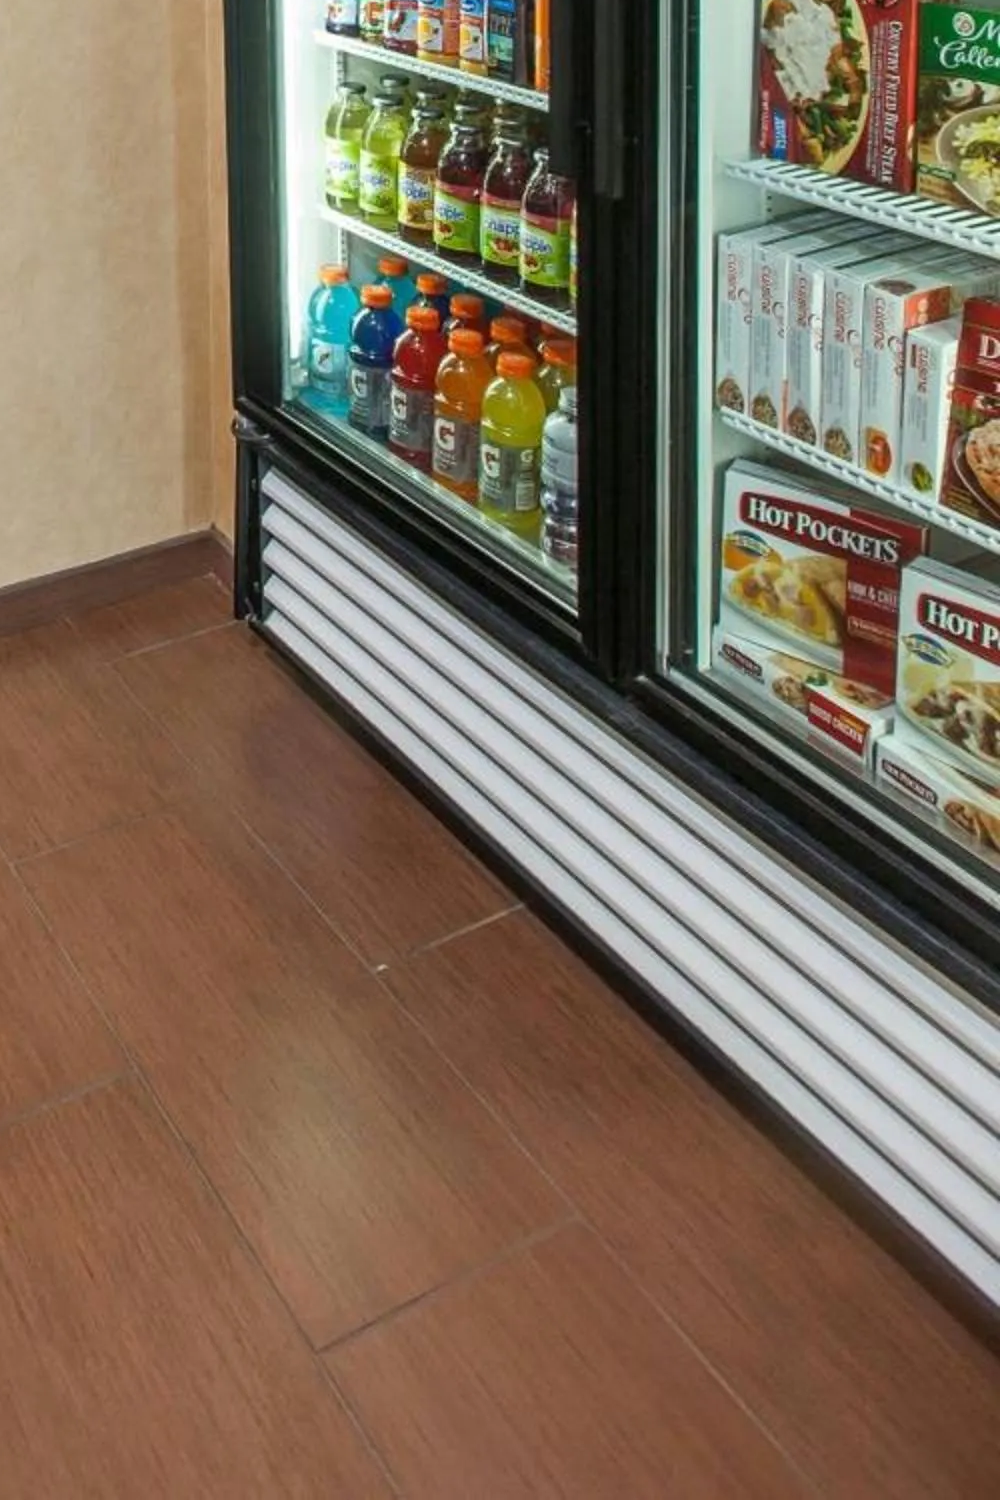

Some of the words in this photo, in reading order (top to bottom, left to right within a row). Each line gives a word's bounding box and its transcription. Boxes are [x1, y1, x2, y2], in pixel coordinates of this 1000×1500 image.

[886, 19, 904, 73] COUNTRY
[884, 73, 900, 112] FRIED
[880, 145, 897, 184] STEAK
[747, 497, 794, 531] HOT
[795, 510, 899, 564] POCKETS
[926, 599, 980, 643] HOT
